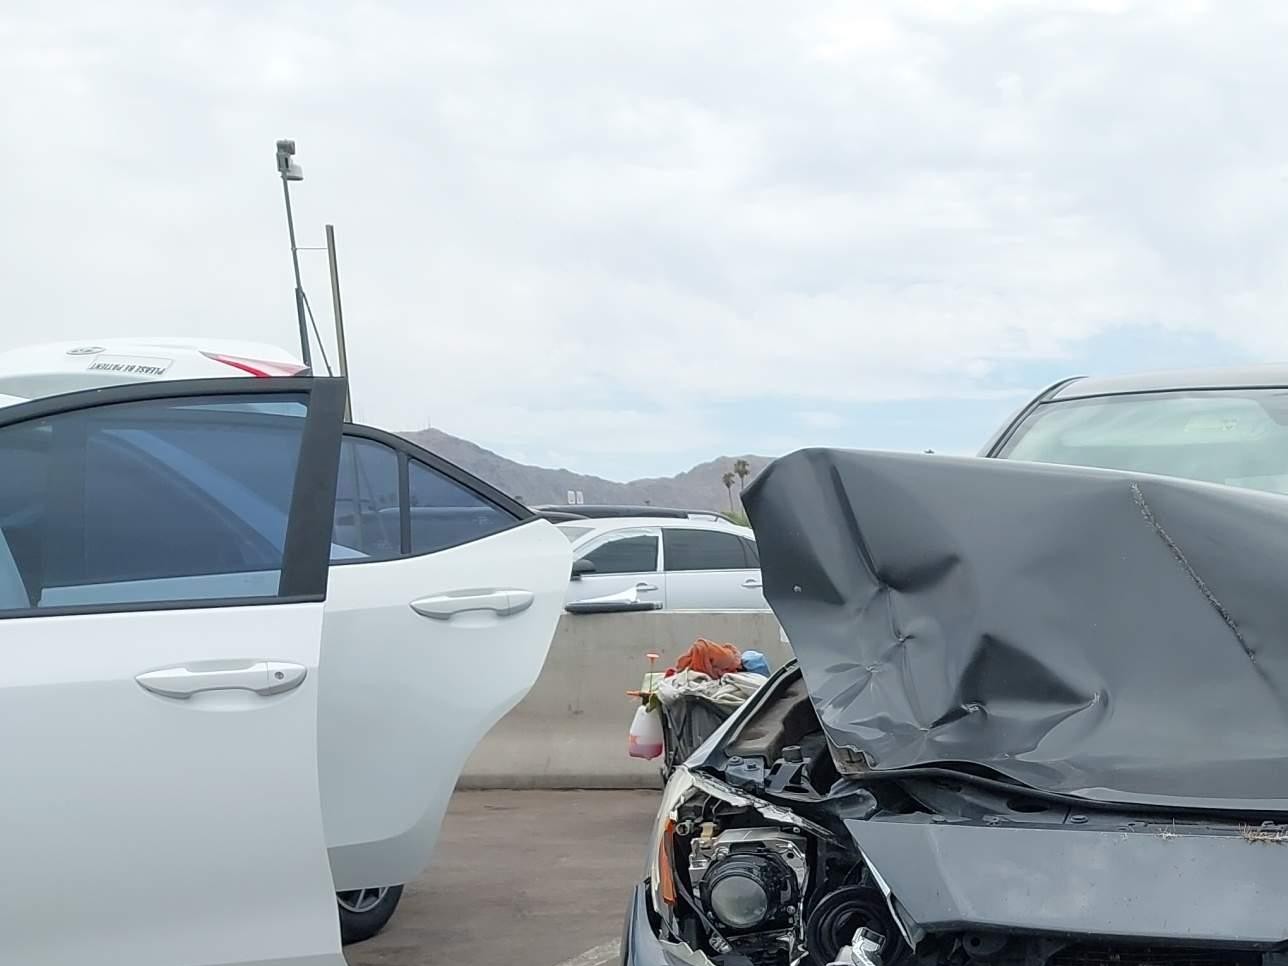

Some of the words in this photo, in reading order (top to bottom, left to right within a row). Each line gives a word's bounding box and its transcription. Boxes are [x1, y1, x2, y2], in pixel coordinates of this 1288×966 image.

[88, 363, 125, 372] PATIENT
[125, 364, 136, 372] BE
[135, 365, 166, 375] PLEASE
